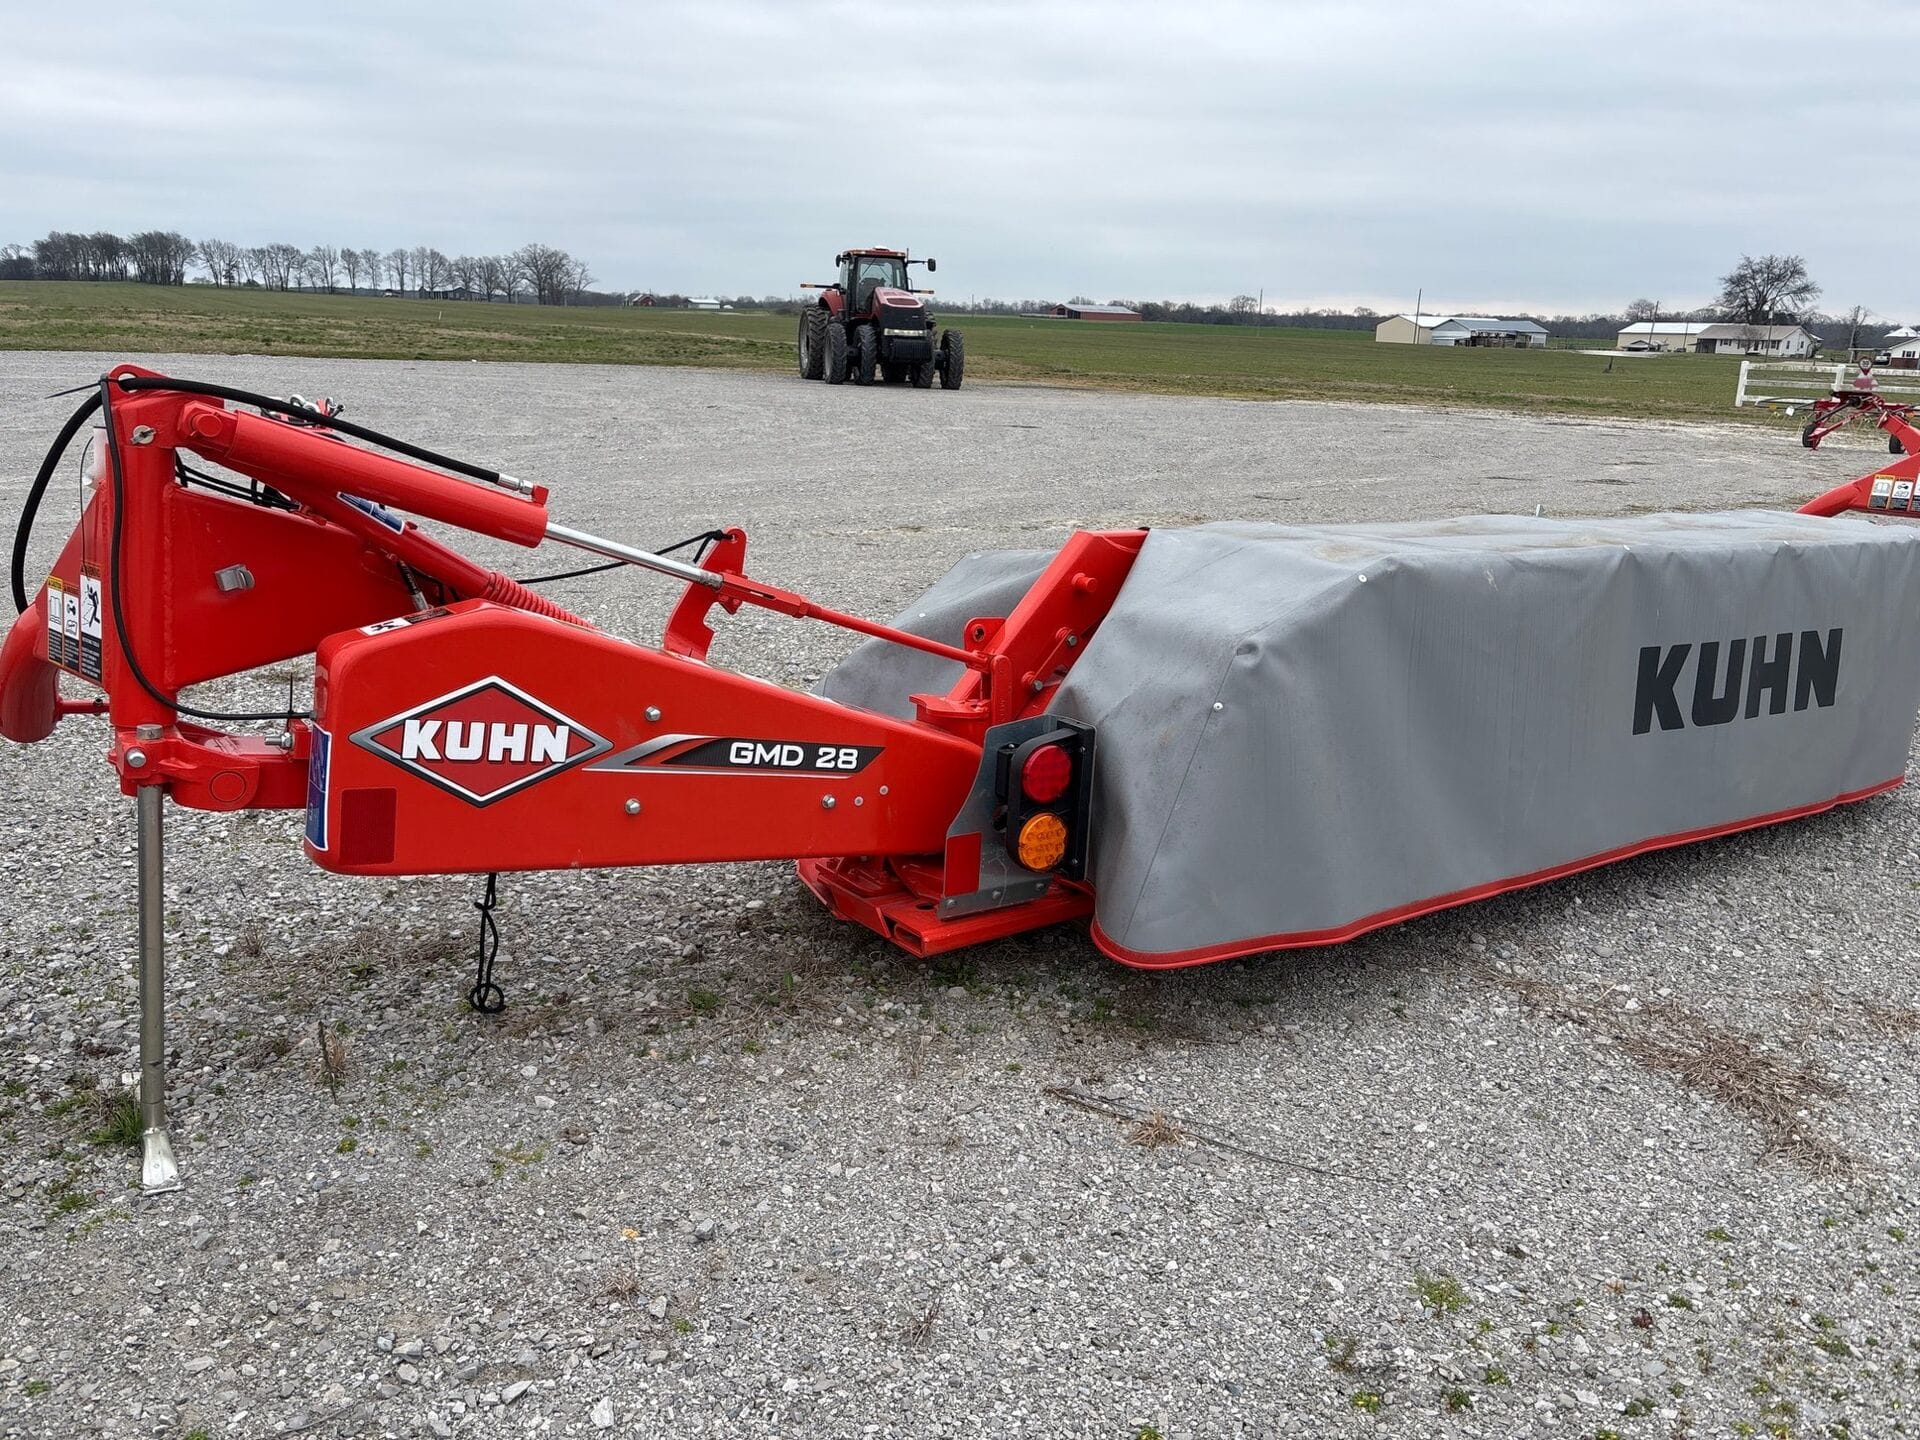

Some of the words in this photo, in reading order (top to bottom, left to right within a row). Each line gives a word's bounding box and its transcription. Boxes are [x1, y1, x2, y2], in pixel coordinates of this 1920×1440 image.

[1632, 628, 1843, 735] KUHN
[402, 719, 570, 763] KUHN
[729, 742, 804, 767] GMD
[815, 747, 859, 770] 28
